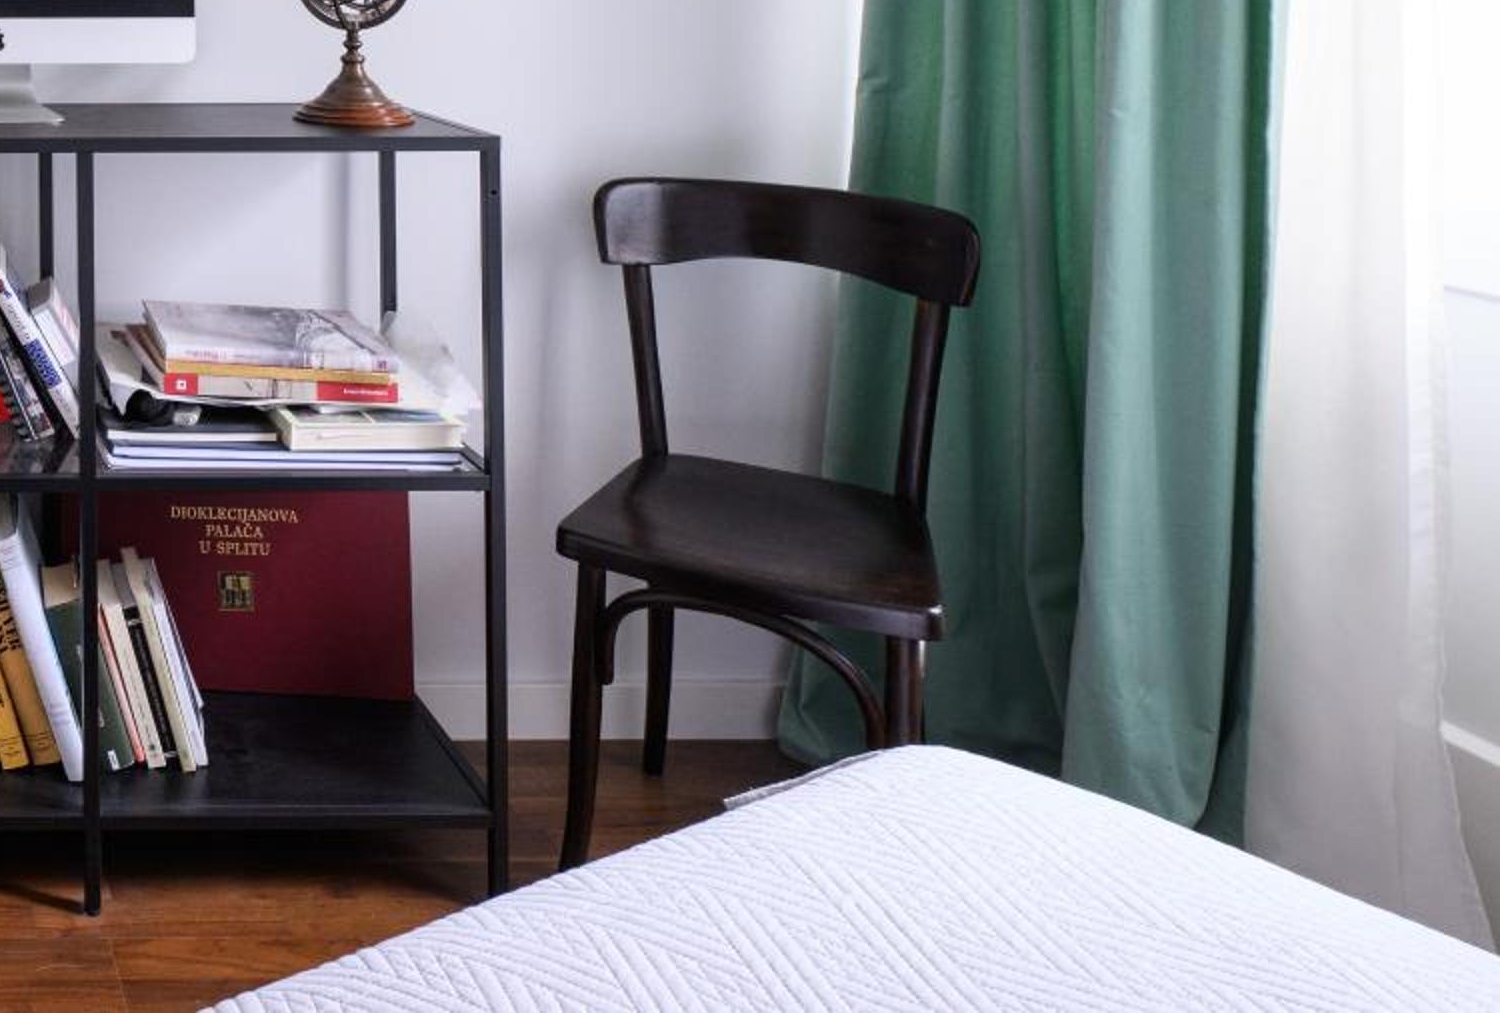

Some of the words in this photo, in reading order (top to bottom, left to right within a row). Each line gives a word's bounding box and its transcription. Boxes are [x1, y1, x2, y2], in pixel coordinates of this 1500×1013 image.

[170, 506, 299, 524] DIOKLECIJANOVA
[204, 523, 264, 539] PALAČA
[198, 540, 211, 555] U
[217, 541, 272, 556] SPLITU
